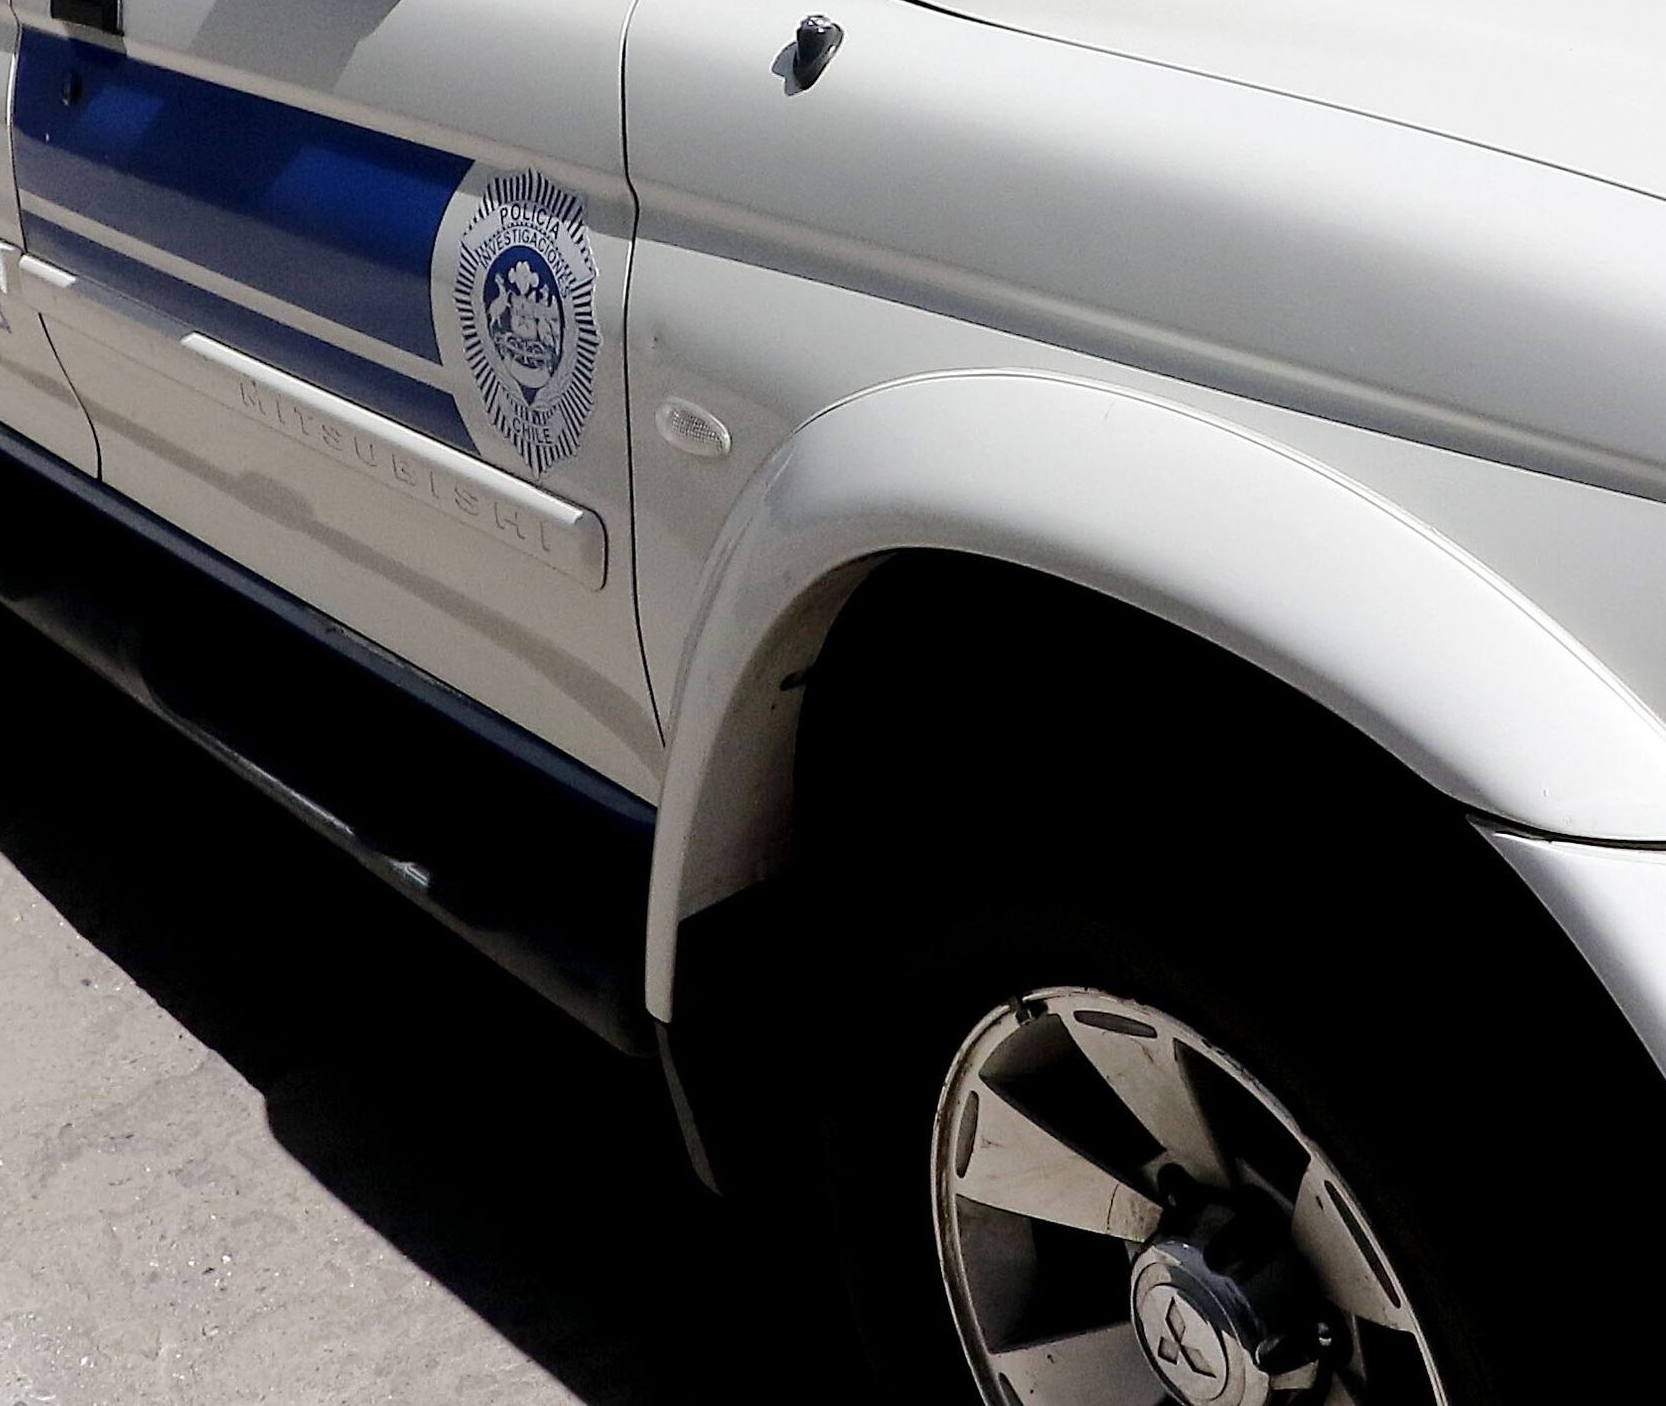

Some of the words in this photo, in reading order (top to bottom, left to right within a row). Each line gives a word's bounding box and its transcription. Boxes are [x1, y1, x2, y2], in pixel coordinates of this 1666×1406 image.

[499, 202, 561, 240] POLICIA
[474, 228, 571, 299] INVESTIGACIONES
[512, 417, 553, 445] CHILE
[238, 378, 552, 553] MITSUBISHI
